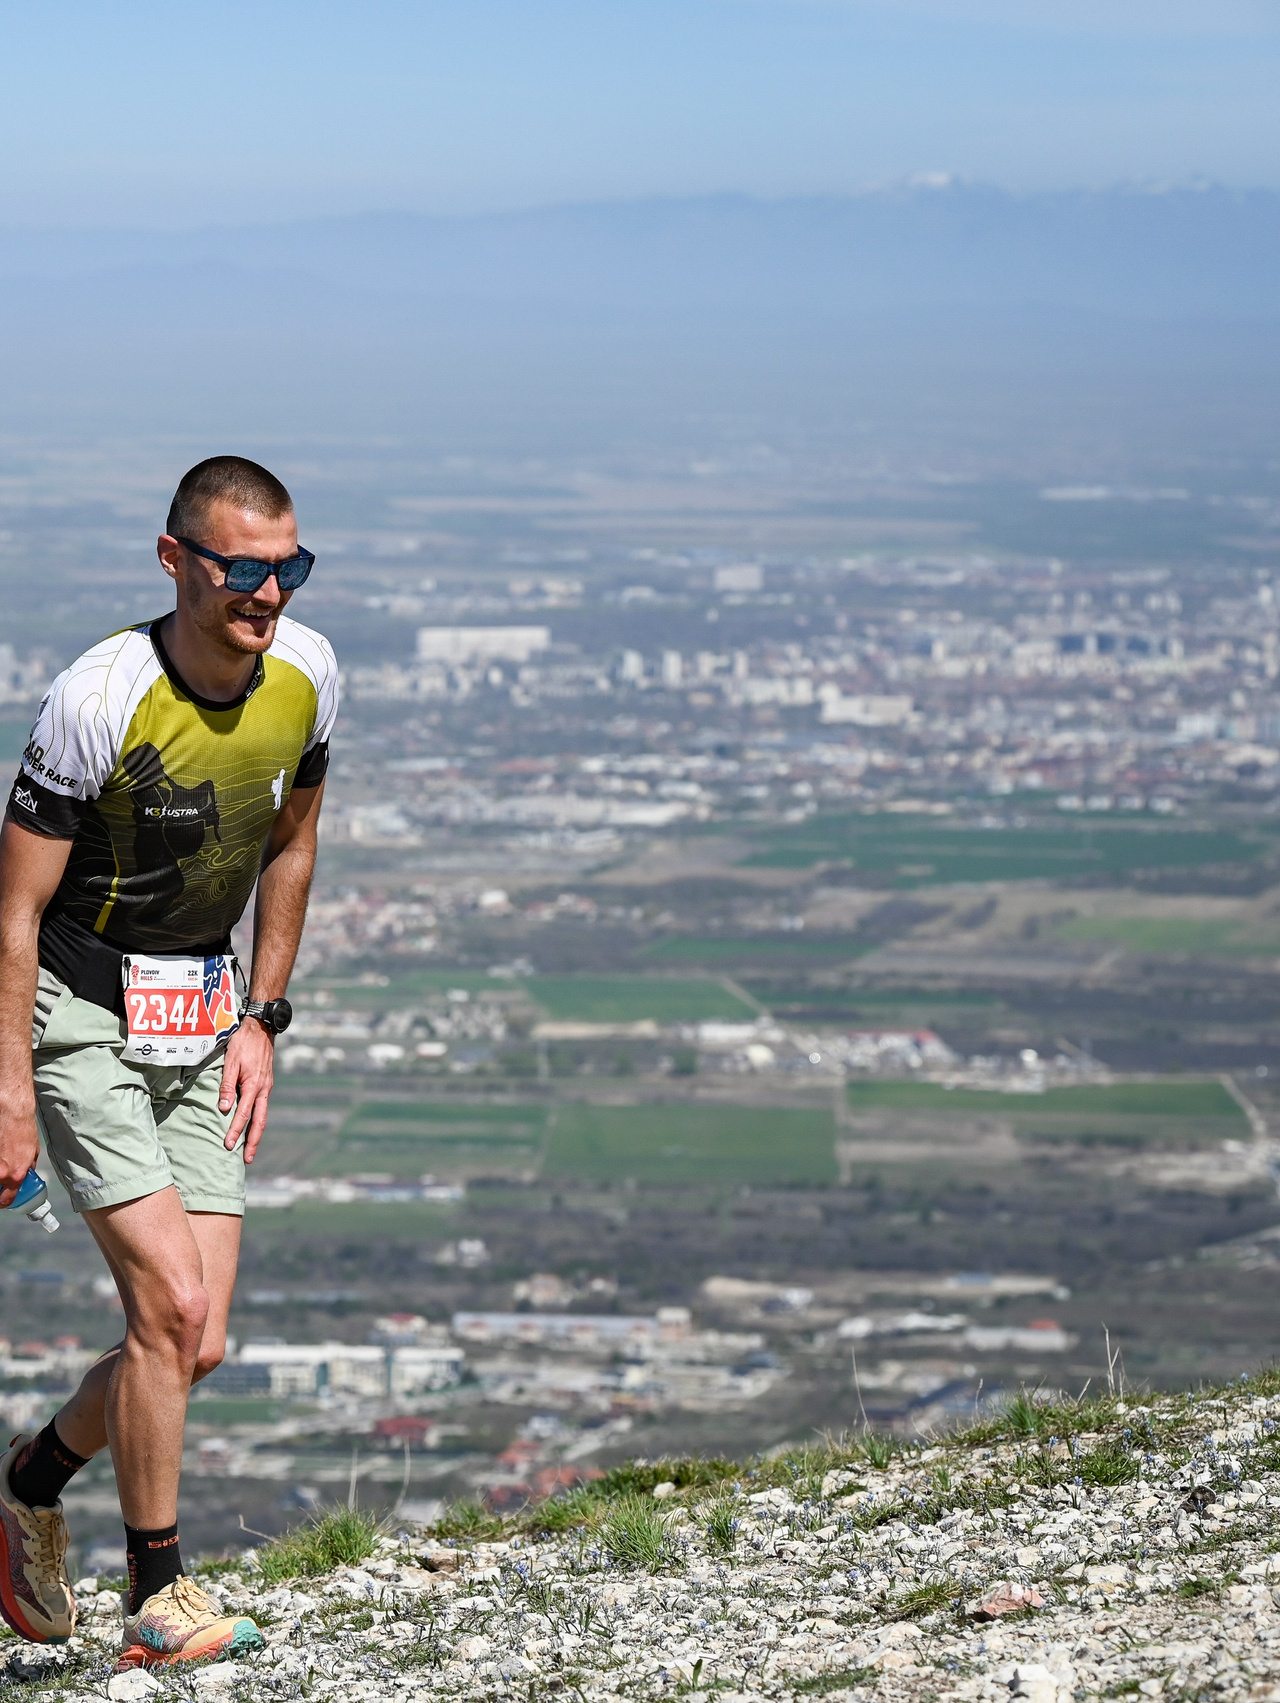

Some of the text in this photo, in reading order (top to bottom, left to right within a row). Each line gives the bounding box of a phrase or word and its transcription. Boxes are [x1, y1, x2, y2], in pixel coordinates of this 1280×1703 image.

[45, 768, 78, 789] RACE
[167, 807, 199, 818] USTRA
[130, 994, 200, 1032] 2344
